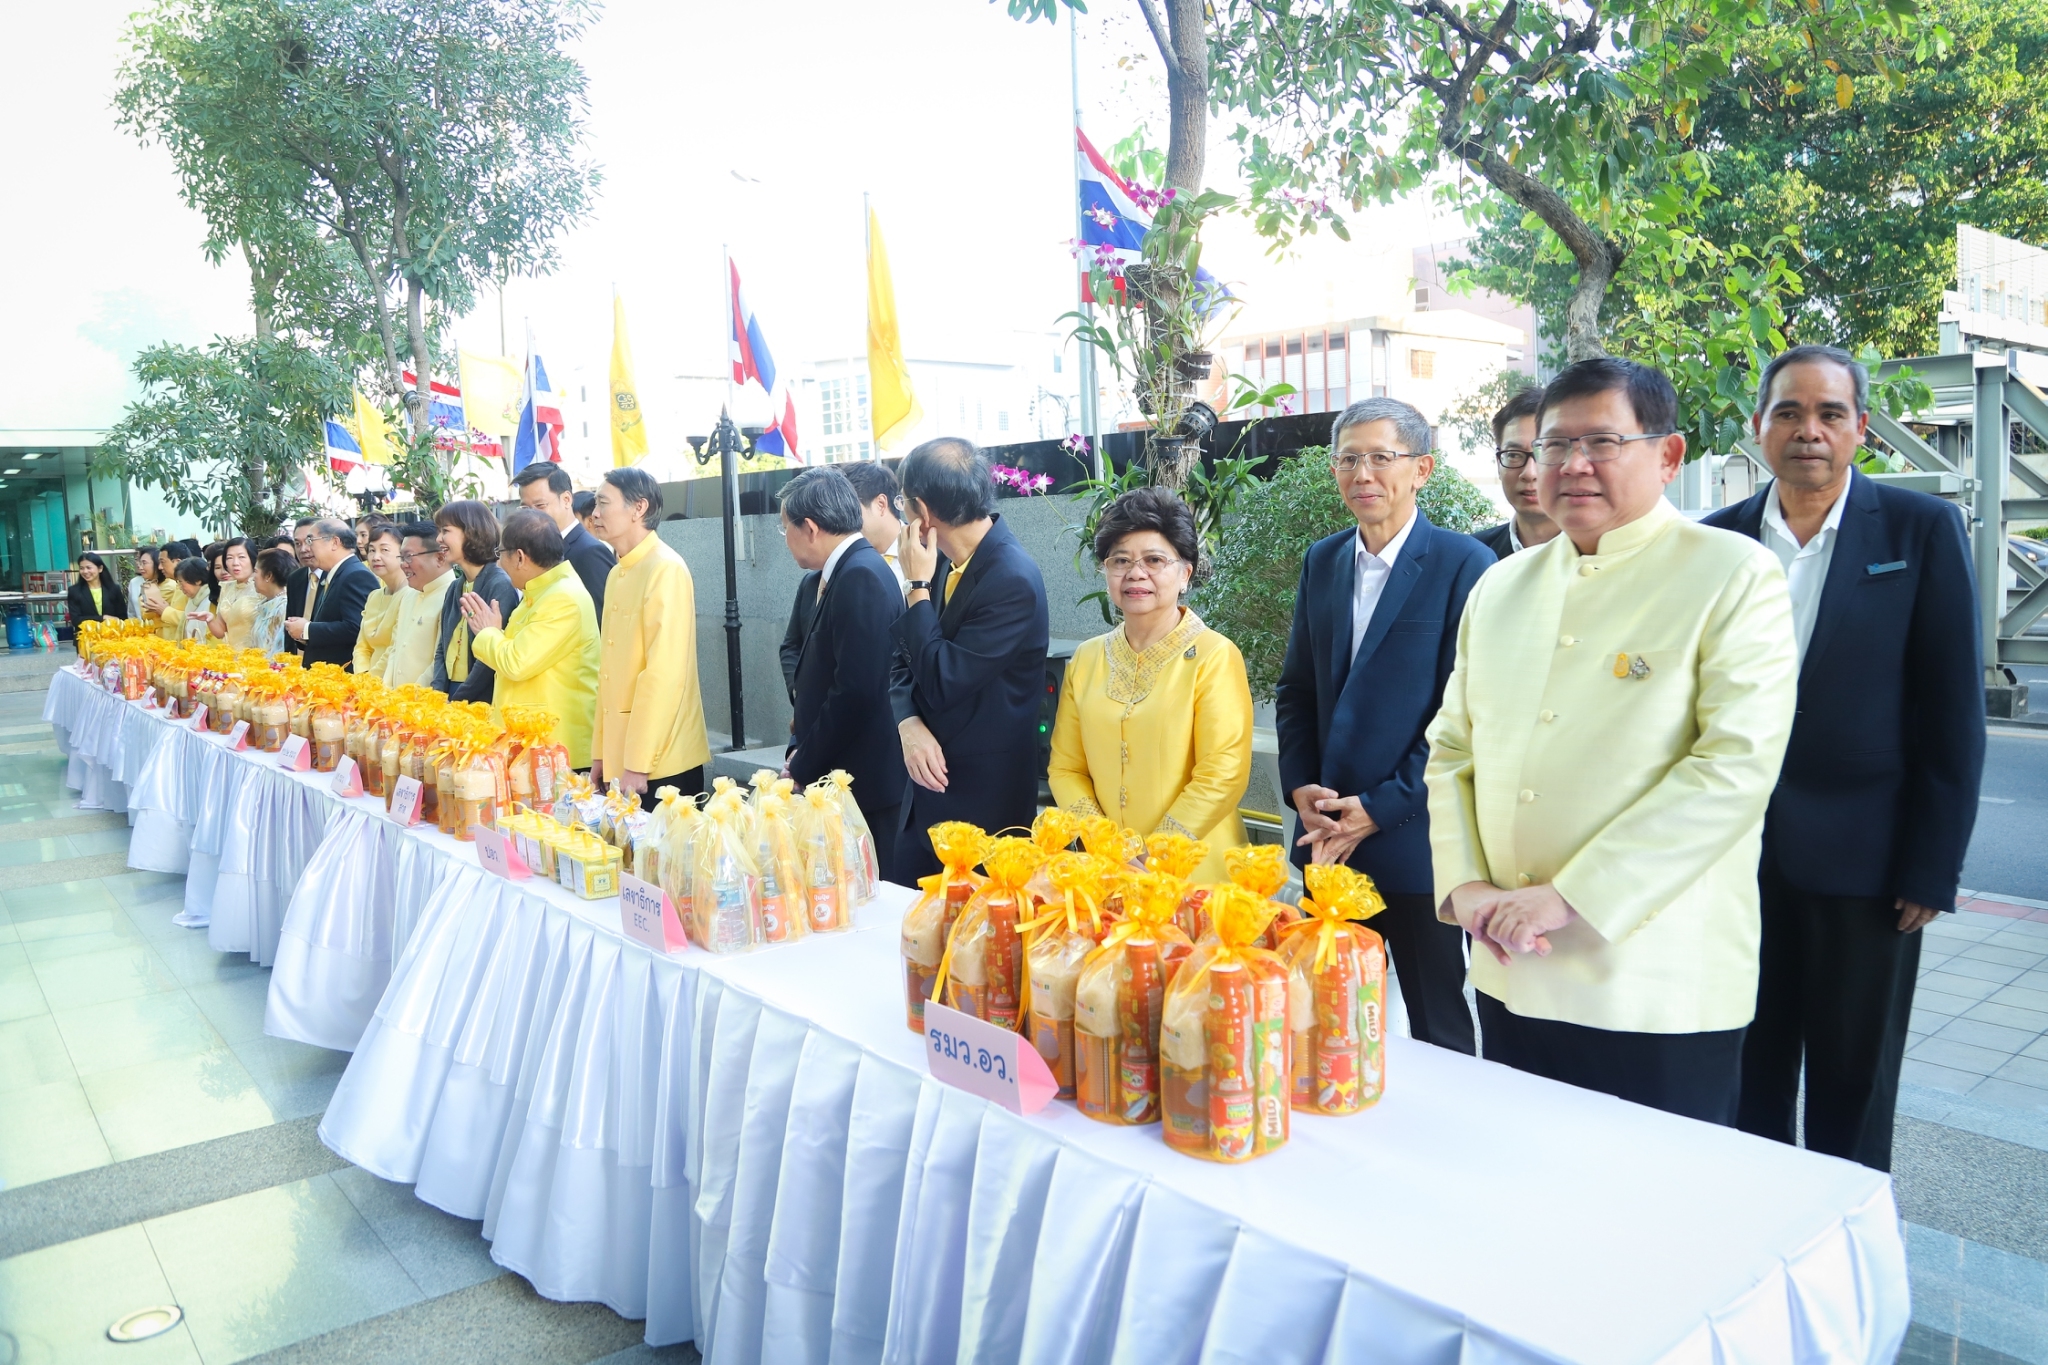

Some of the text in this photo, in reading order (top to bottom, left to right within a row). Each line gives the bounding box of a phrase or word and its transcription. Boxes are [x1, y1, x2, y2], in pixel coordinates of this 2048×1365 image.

[622, 886, 661, 917] เลขาธิการ
[633, 912, 650, 933] EEC.
[1367, 1004, 1378, 1039] MILO
[929, 1028, 1015, 1084] รมว.อว.
[1267, 1098, 1279, 1136] MILO
